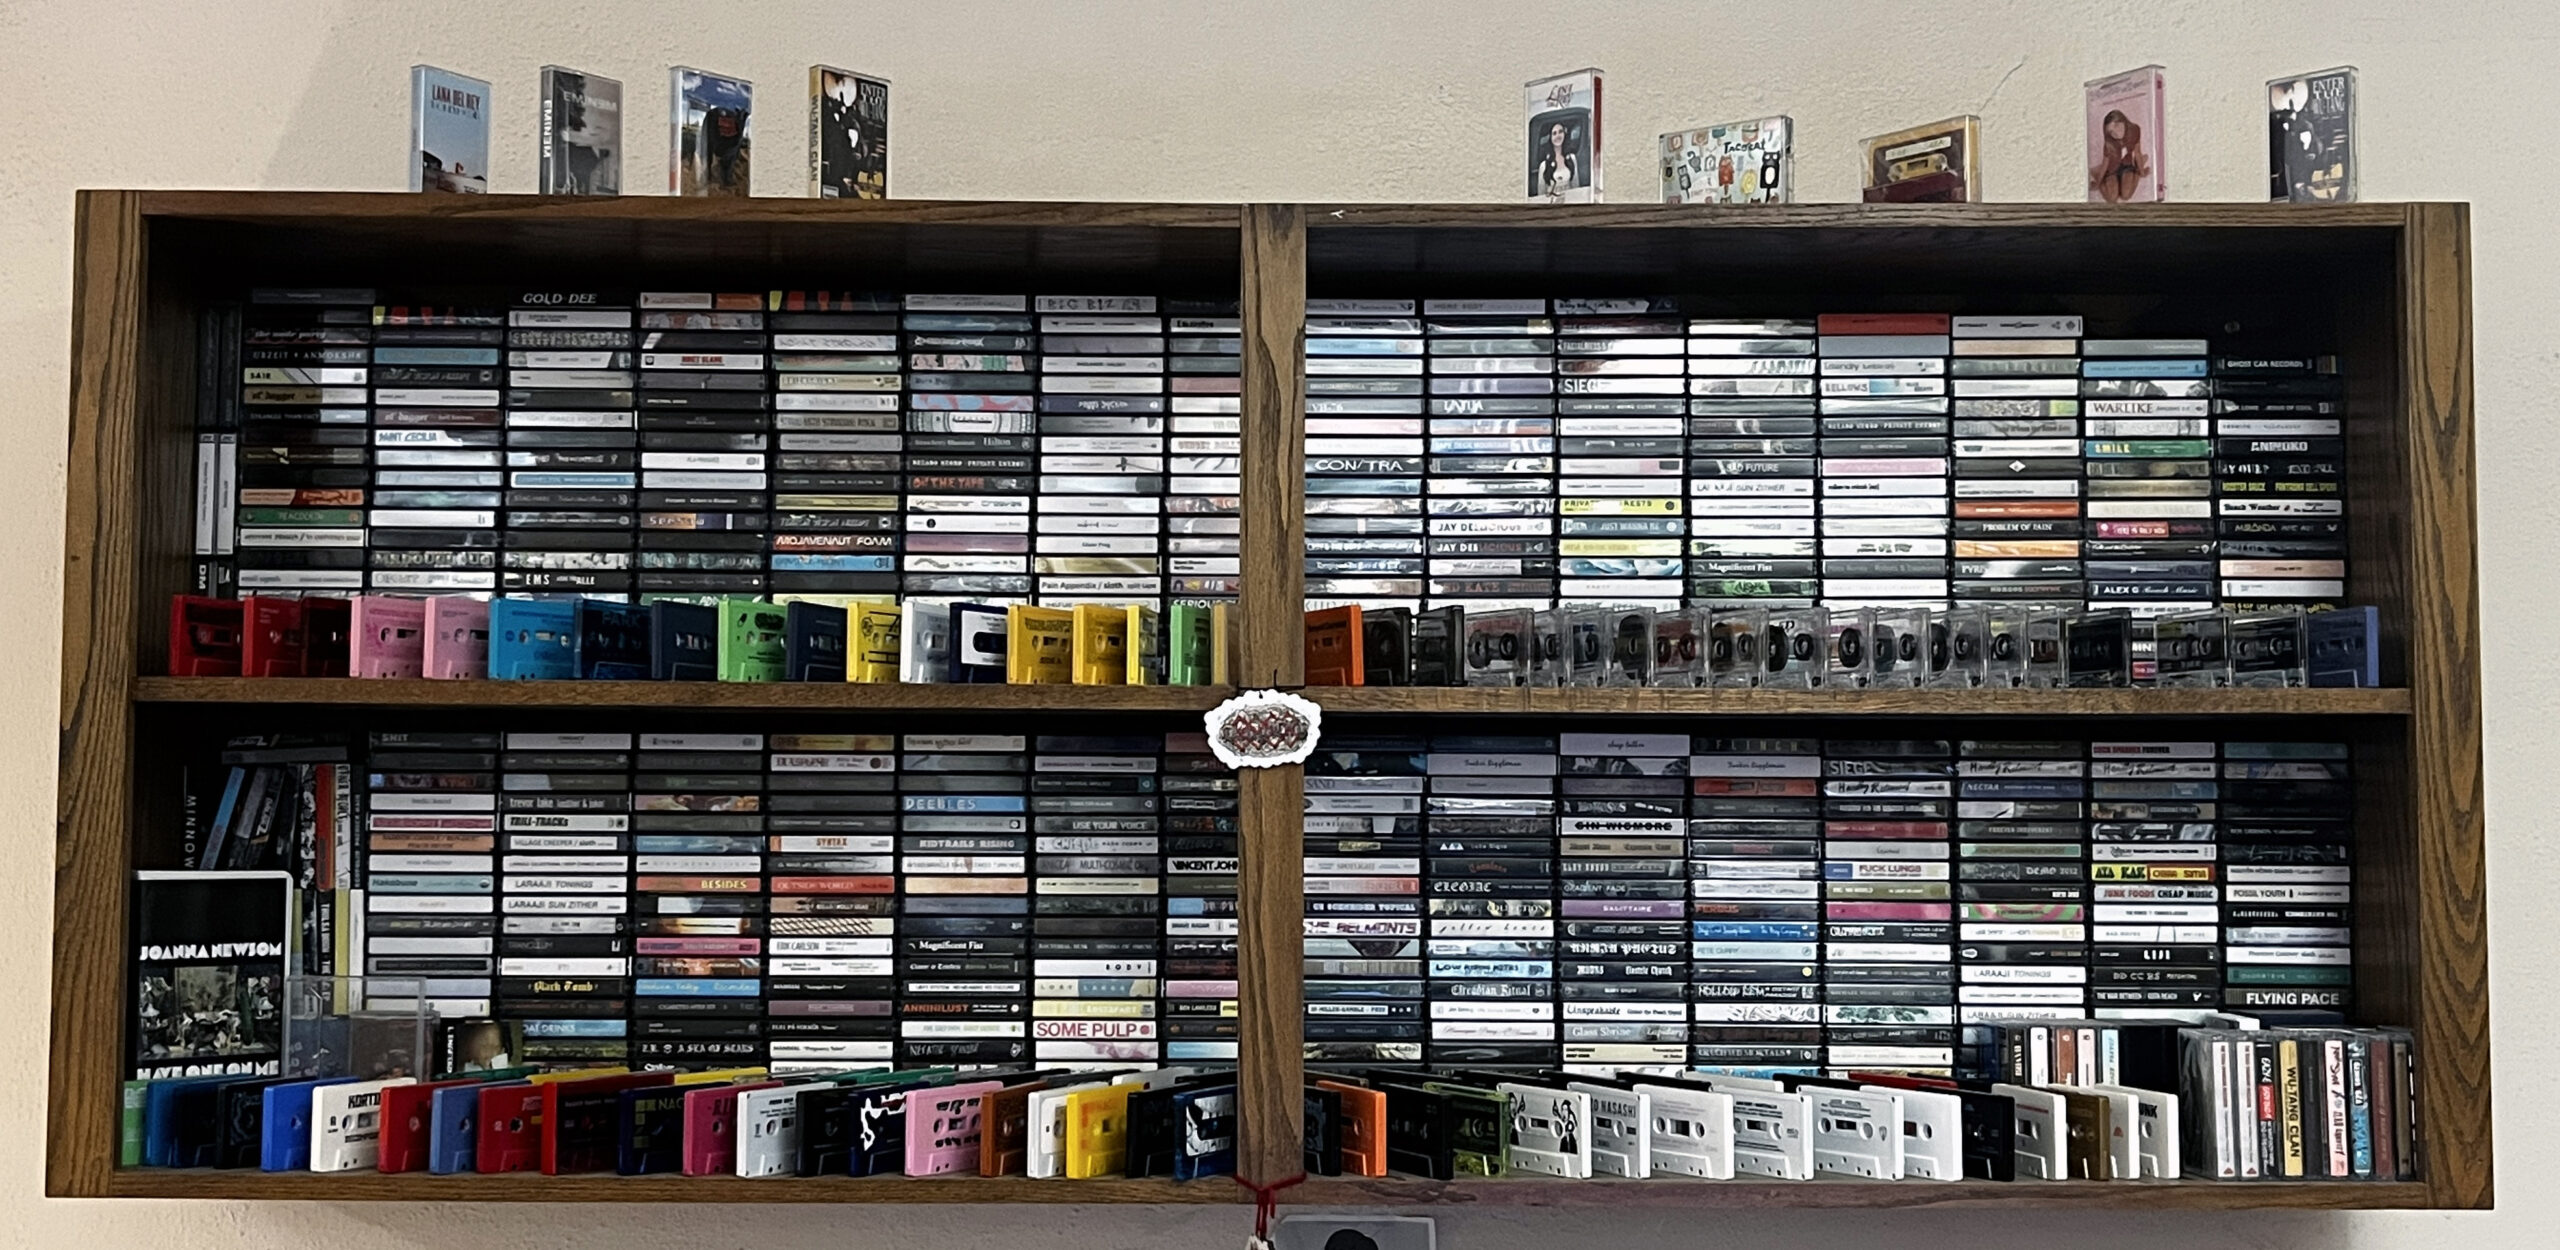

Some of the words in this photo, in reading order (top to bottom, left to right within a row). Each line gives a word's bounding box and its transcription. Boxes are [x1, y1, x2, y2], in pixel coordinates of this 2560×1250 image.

[543, 100, 553, 158] EMINEM
[523, 293, 562, 305] GOLD
[568, 293, 597, 304] DEE
[2093, 403, 2153, 413] WARLIKE
[1437, 543, 1456, 552] JAY
[702, 880, 747, 889] BESIDES
[2103, 889, 2125, 898] JUNK
[139, 945, 209, 961] JOANNA
[211, 942, 282, 958] NEWSOM
[2246, 993, 2297, 1005] FLYING
[2301, 993, 2339, 1005] PACE
[1036, 1023, 1088, 1036] SOME
[1092, 1023, 1137, 1037] PULP
[255, 1060, 279, 1076] ME
[2287, 1067, 2299, 1122] WU-TANG
[2289, 1126, 2300, 1157] CLAN
